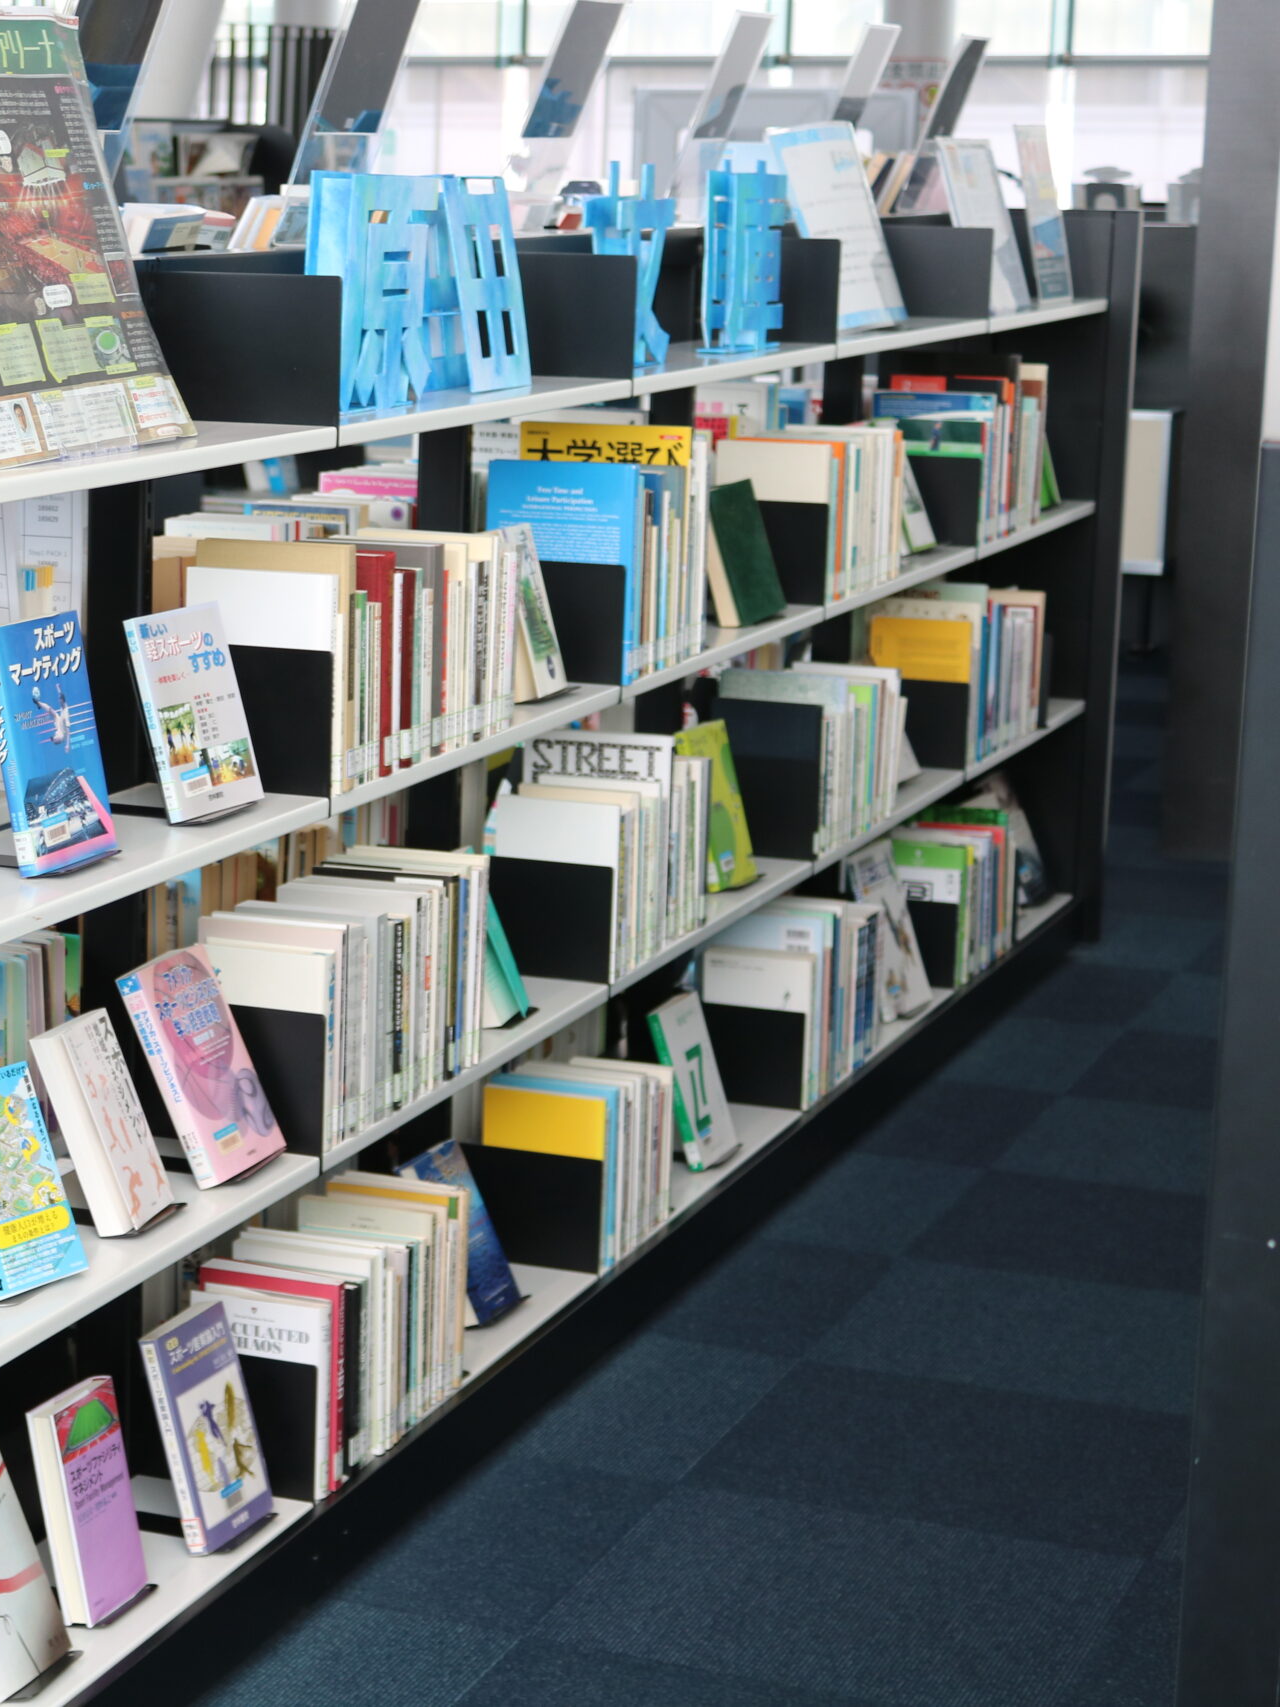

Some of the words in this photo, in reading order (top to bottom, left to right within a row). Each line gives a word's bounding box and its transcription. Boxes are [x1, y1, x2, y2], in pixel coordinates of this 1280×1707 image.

[527, 437, 684, 466] 大学選び
[34, 620, 75, 651] スポーツ
[139, 623, 168, 640] 新しい
[8, 646, 81, 686] マーケティング
[187, 648, 226, 673] すすめ
[531, 738, 662, 780] STREET
[2, 1210, 58, 1235] 健康人口が増える
